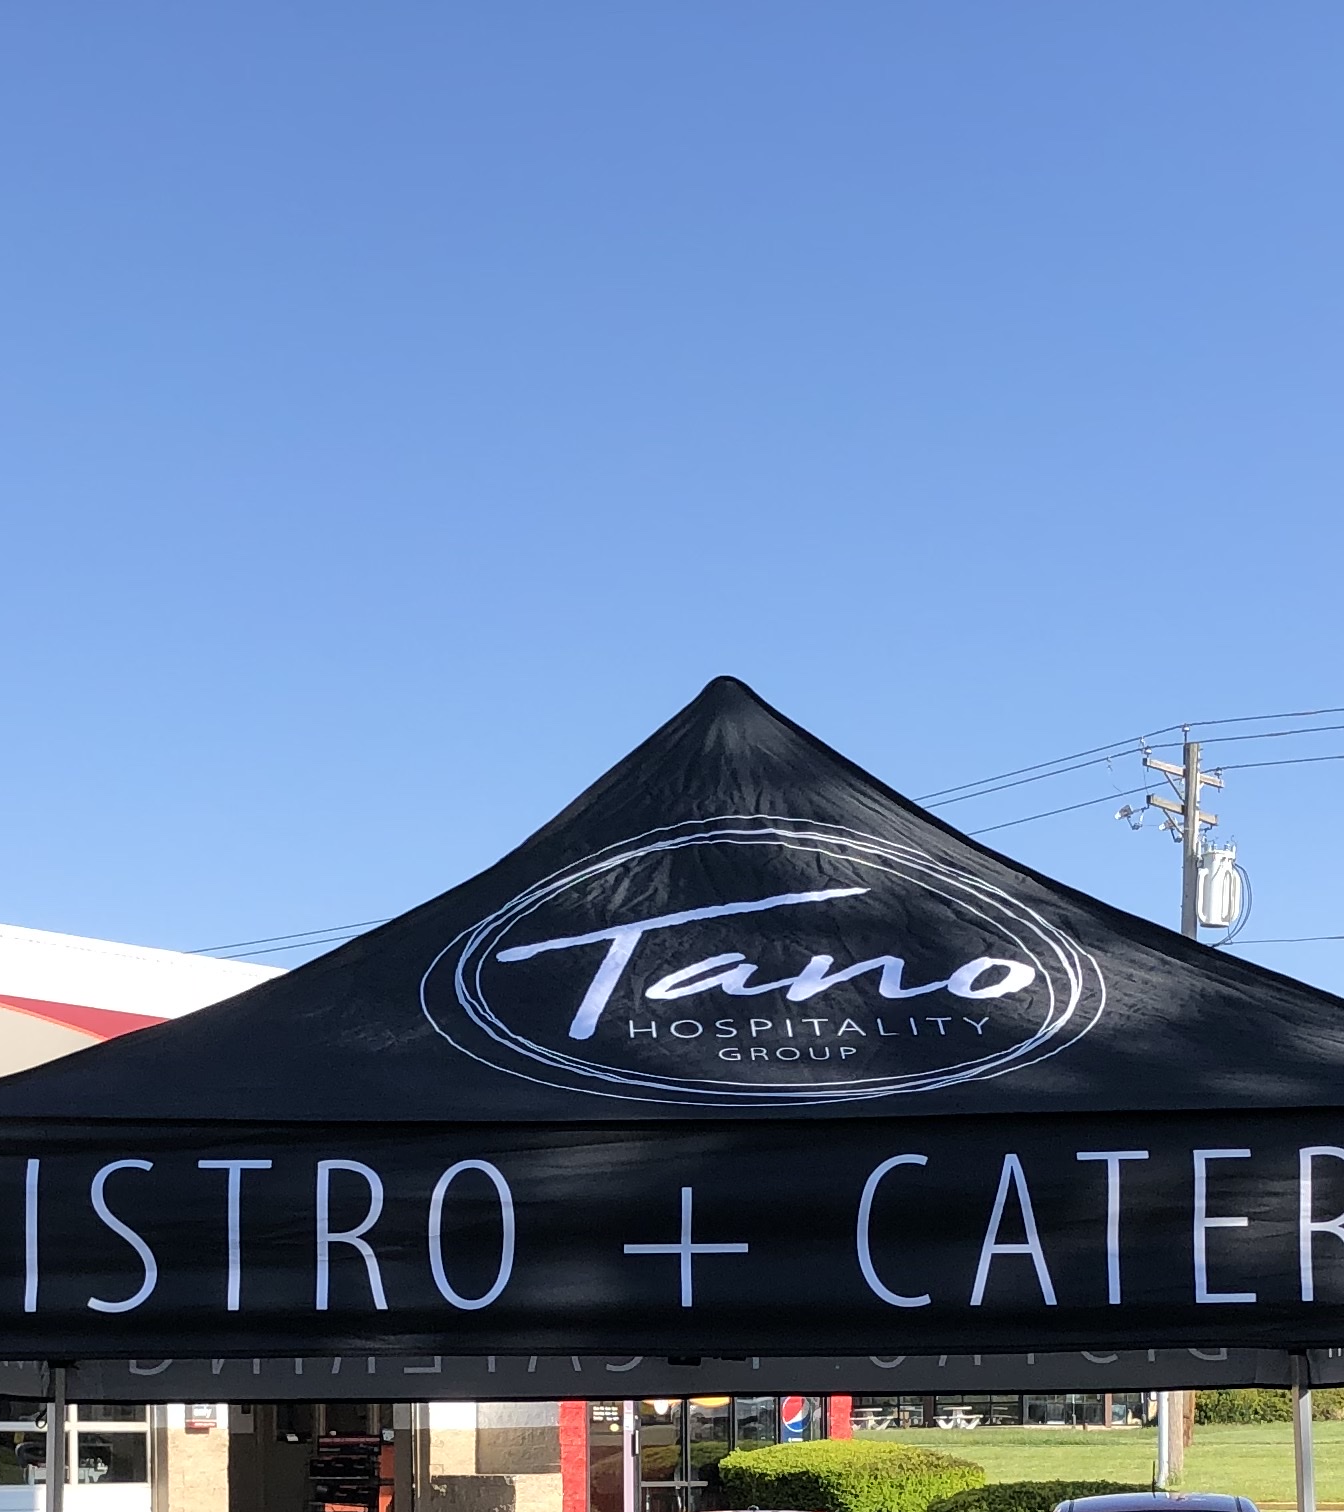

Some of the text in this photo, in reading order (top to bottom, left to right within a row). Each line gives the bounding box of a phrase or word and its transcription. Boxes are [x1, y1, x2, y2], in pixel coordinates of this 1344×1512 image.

[496, 887, 1037, 1040] Tano
[628, 1016, 991, 1039] HOSPITALITY
[718, 1046, 858, 1061] GROUP
